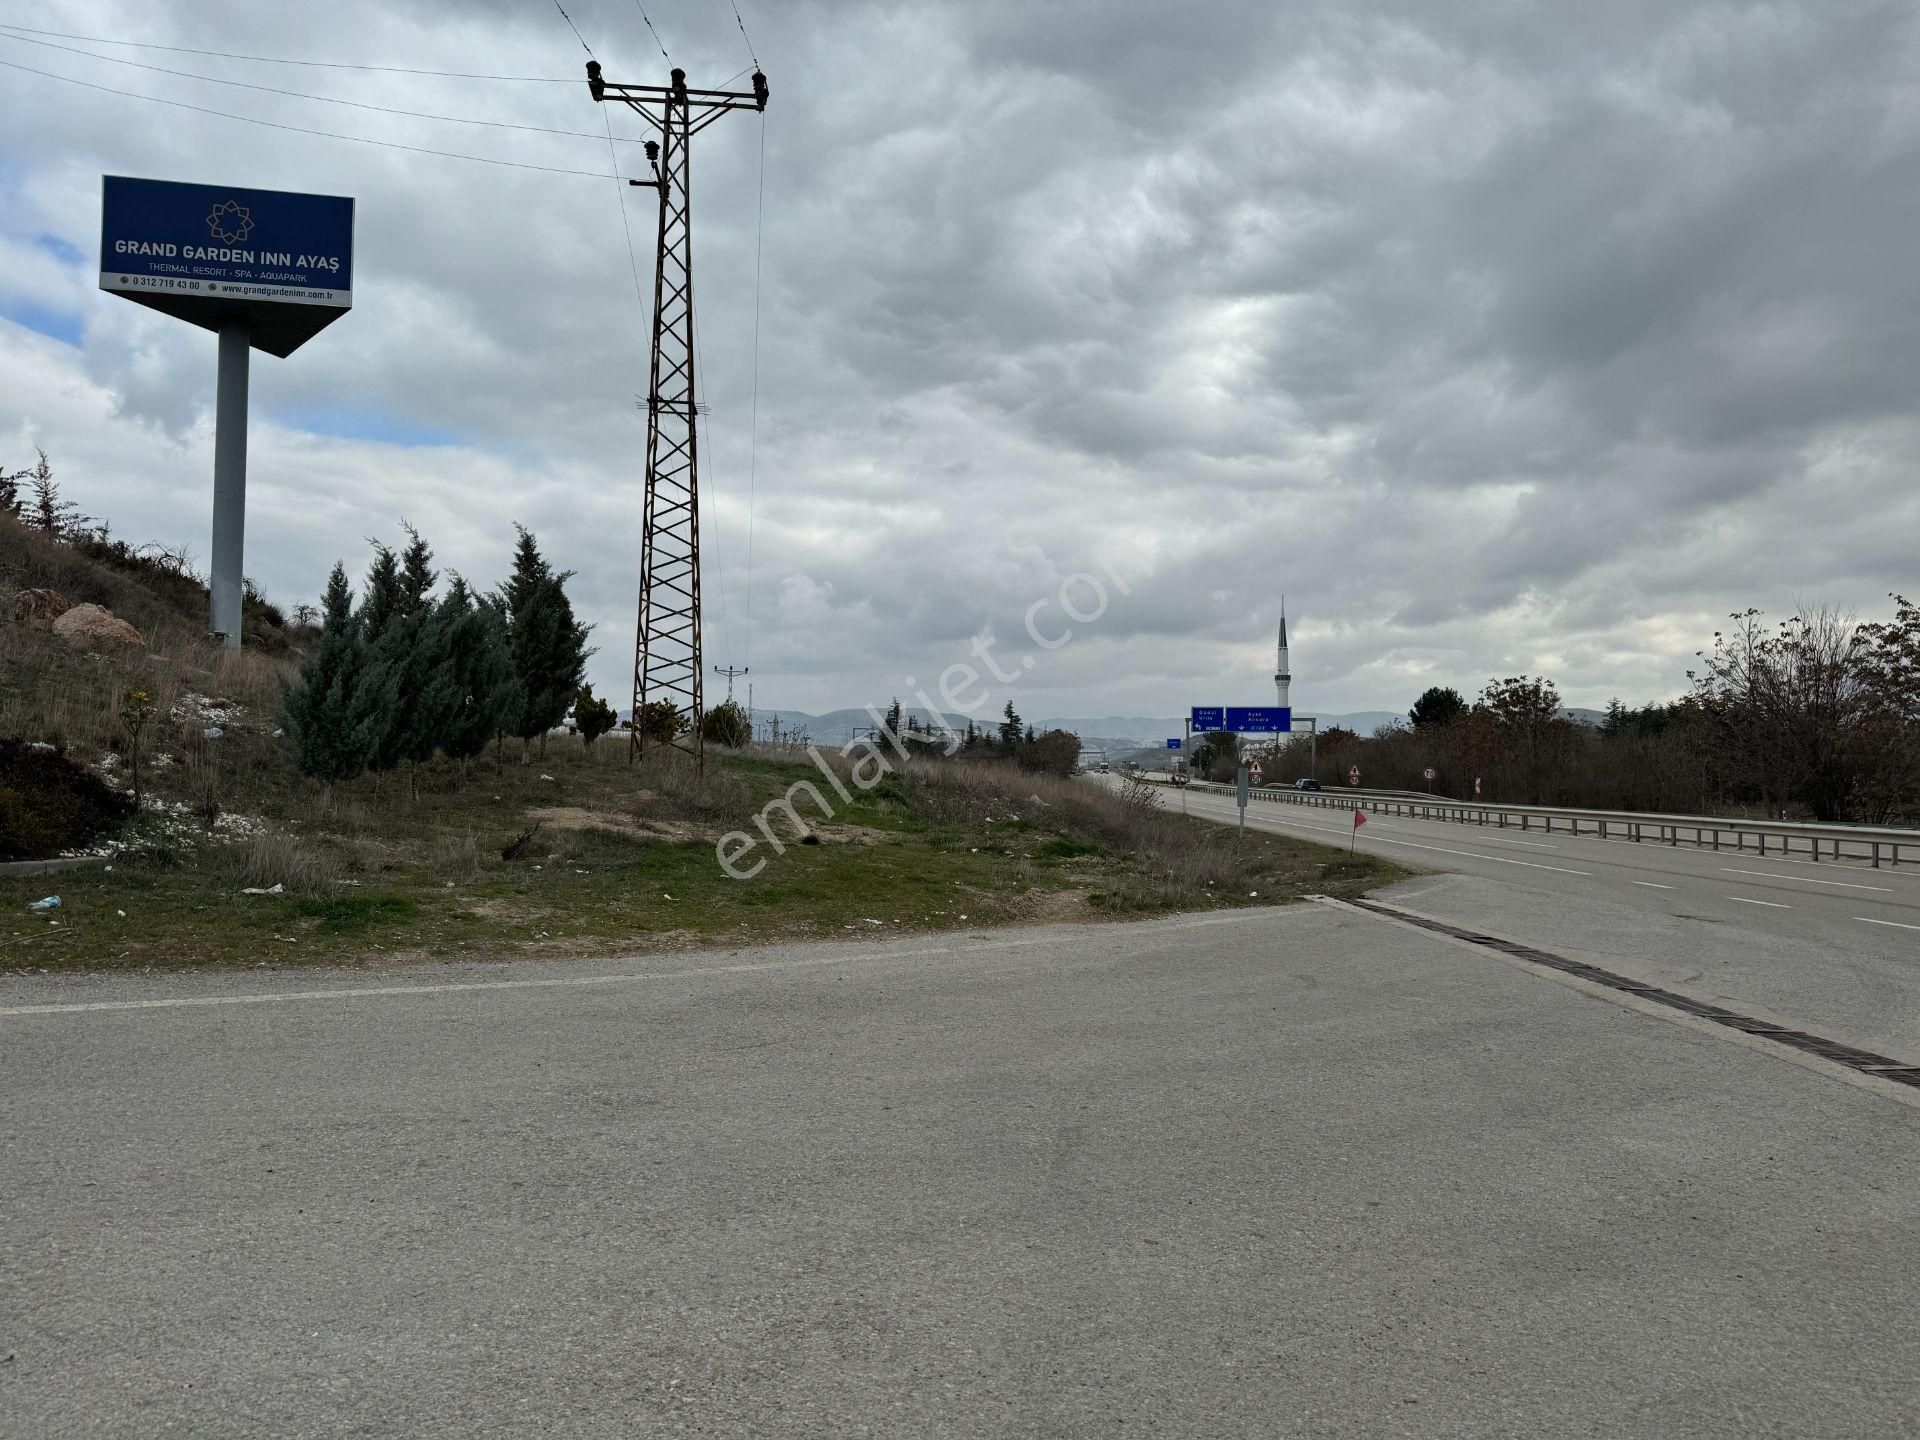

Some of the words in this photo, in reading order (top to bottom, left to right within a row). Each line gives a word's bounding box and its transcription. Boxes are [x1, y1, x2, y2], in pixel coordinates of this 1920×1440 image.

[115, 239, 177, 257] GRAND
[182, 245, 254, 264] GARDEN
[260, 251, 291, 266] INN
[295, 254, 340, 274] AYAŞ
[148, 262, 191, 274] THERMAL
[193, 266, 228, 277] RESORT
[234, 269, 252, 278] SPA
[259, 271, 307, 283] AQUAPARK
[133, 276, 139, 285] 0
[140, 277, 157, 286] 312
[159, 279, 174, 288] 719
[176, 280, 187, 289] 43
[189, 281, 200, 290] 00
[222, 285, 334, 299] www.grandgardeninn.com.tr
